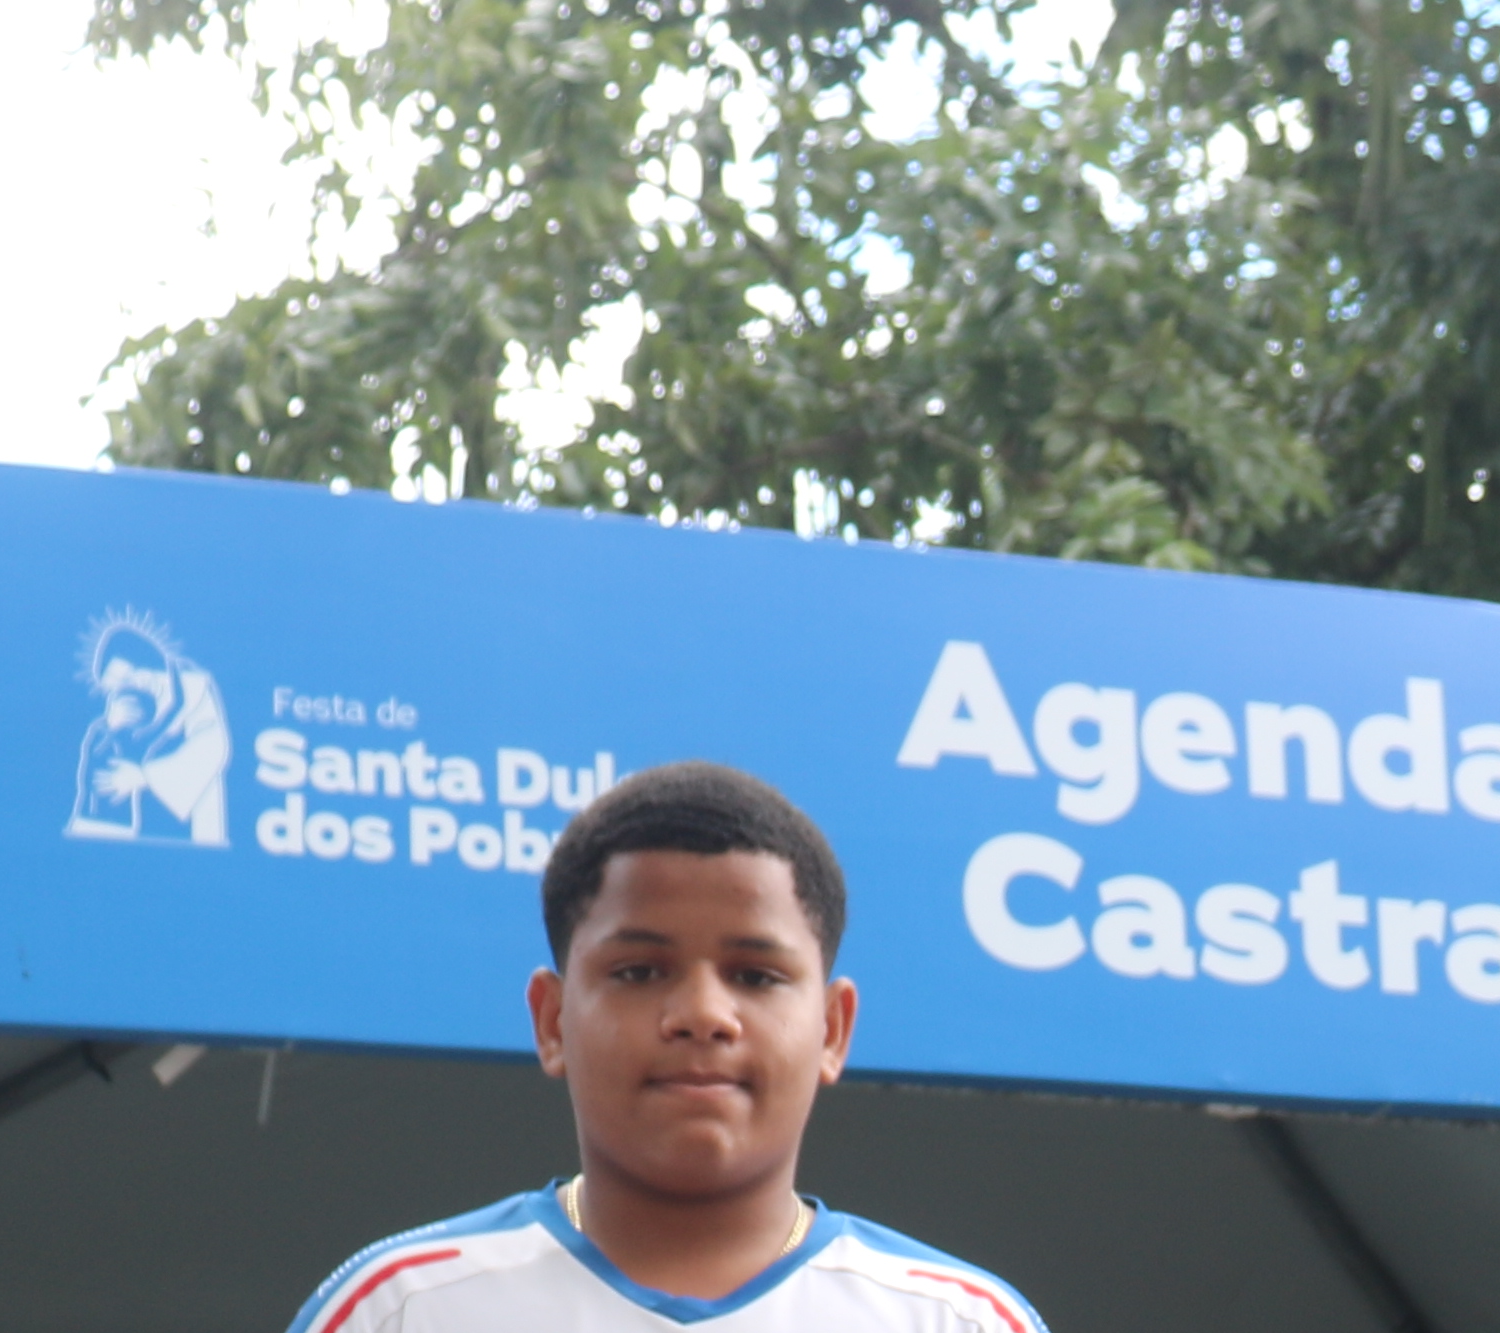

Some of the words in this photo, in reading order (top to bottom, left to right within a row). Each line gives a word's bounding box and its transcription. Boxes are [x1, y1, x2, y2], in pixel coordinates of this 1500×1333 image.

[272, 685, 367, 726] Festa
[377, 696, 418, 729] de
[254, 727, 486, 804] Santa
[497, 748, 629, 811] Dul
[255, 792, 396, 863] dos
[409, 805, 561, 874] Pob
